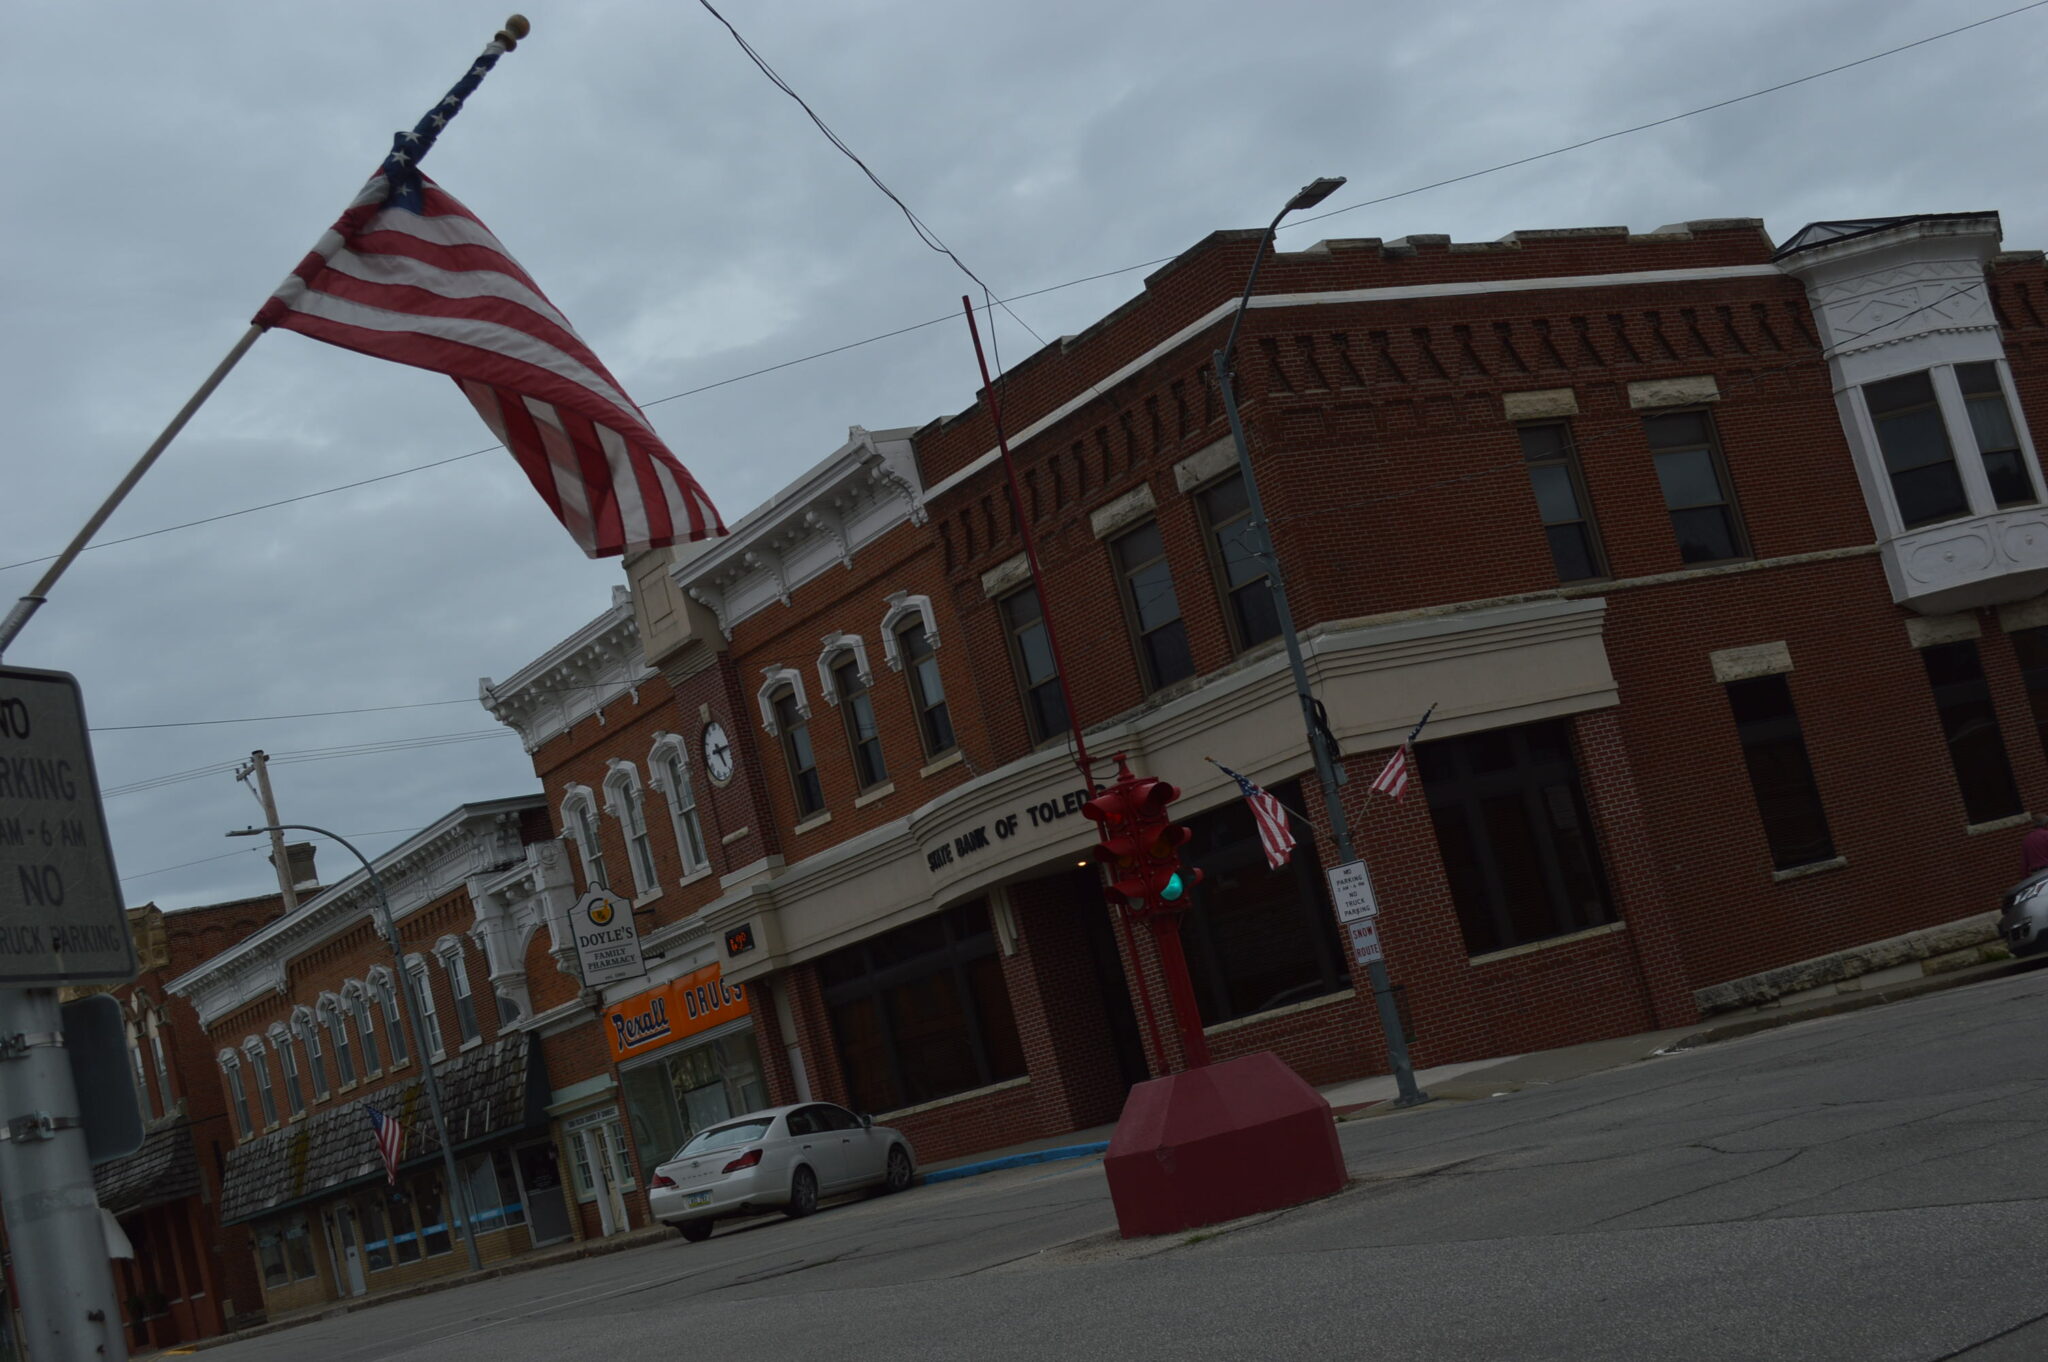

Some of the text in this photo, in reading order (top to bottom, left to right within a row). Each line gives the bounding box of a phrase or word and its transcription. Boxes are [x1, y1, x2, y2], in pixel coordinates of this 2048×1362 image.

[61, 819, 87, 847] AM
[928, 784, 1106, 872] STATE BANK OF TOLED
[18, 865, 64, 906] NO
[1336, 875, 1362, 886] PARKING
[1344, 905, 1370, 916] PARKING
[1345, 898, 1366, 908] TRUCK
[50, 925, 121, 953] PARKING
[579, 926, 634, 948] DOYLE'S
[1352, 926, 1372, 939] SNOW
[594, 947, 627, 961] FAMILY
[1356, 944, 1379, 958] ROUTE
[587, 954, 636, 970] PHARMACY
[611, 977, 744, 1053] Rexall DRUGS
